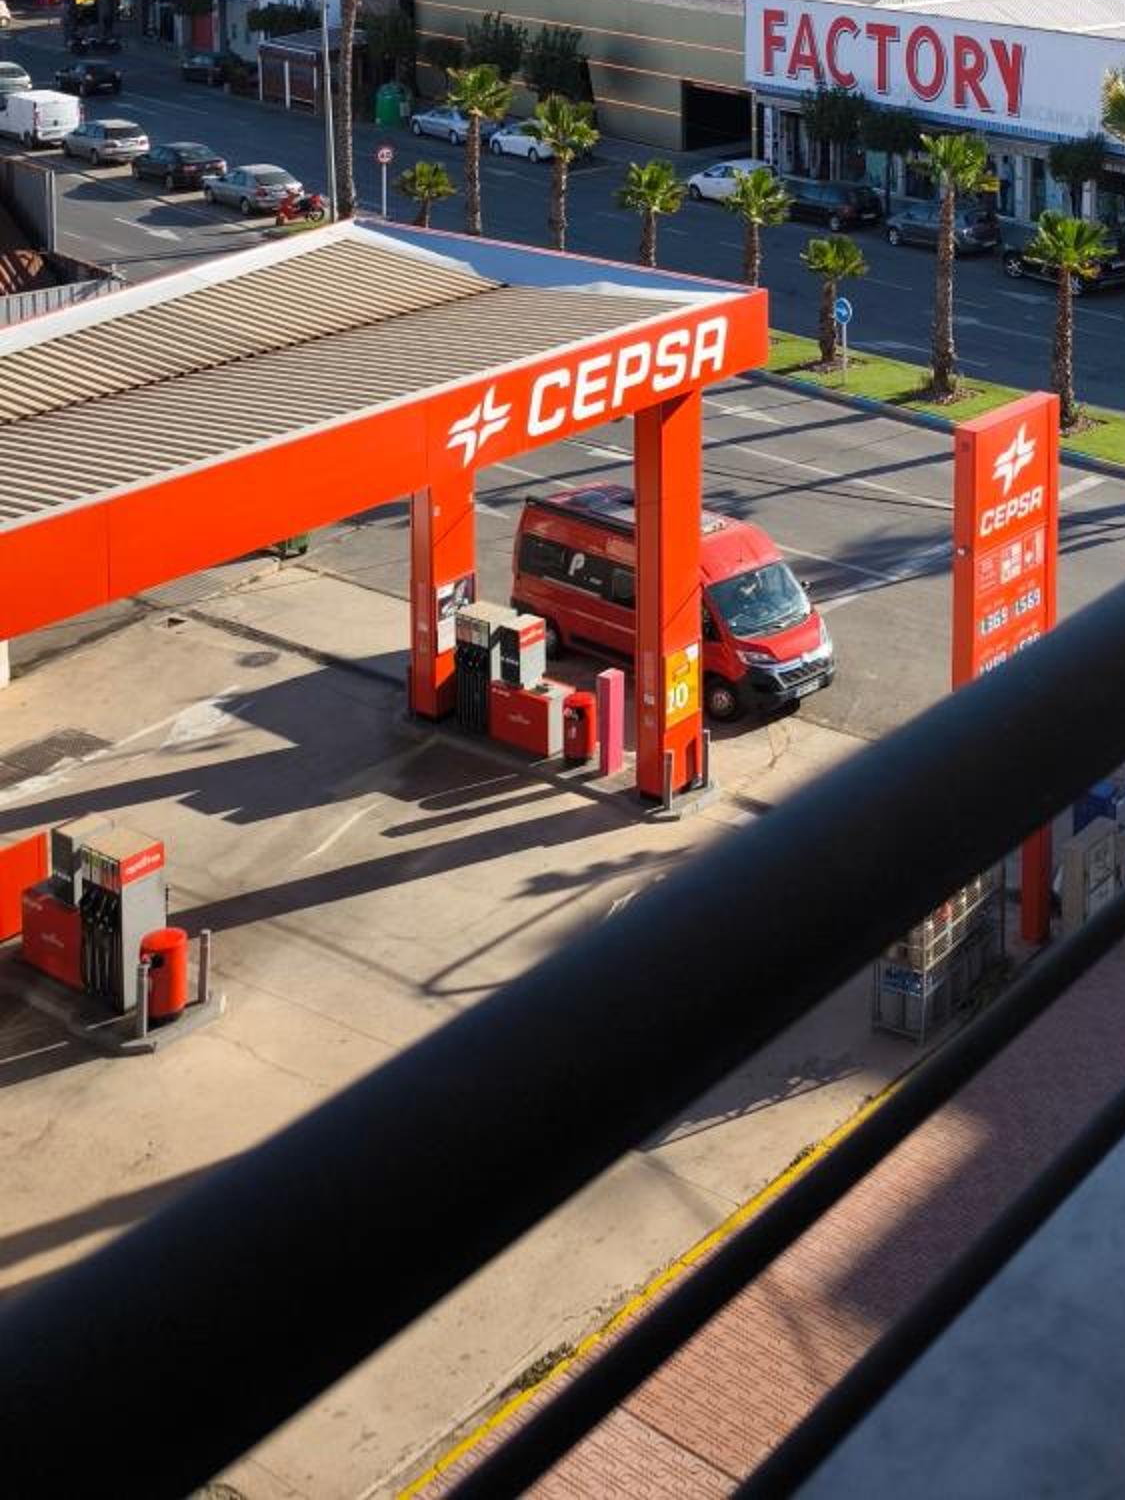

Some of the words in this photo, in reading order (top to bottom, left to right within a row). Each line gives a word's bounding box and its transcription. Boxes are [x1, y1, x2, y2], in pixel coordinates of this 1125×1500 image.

[762, 7, 1025, 118] FACTORY
[526, 315, 729, 437] CEPSA
[979, 485, 1044, 537] CEPSA
